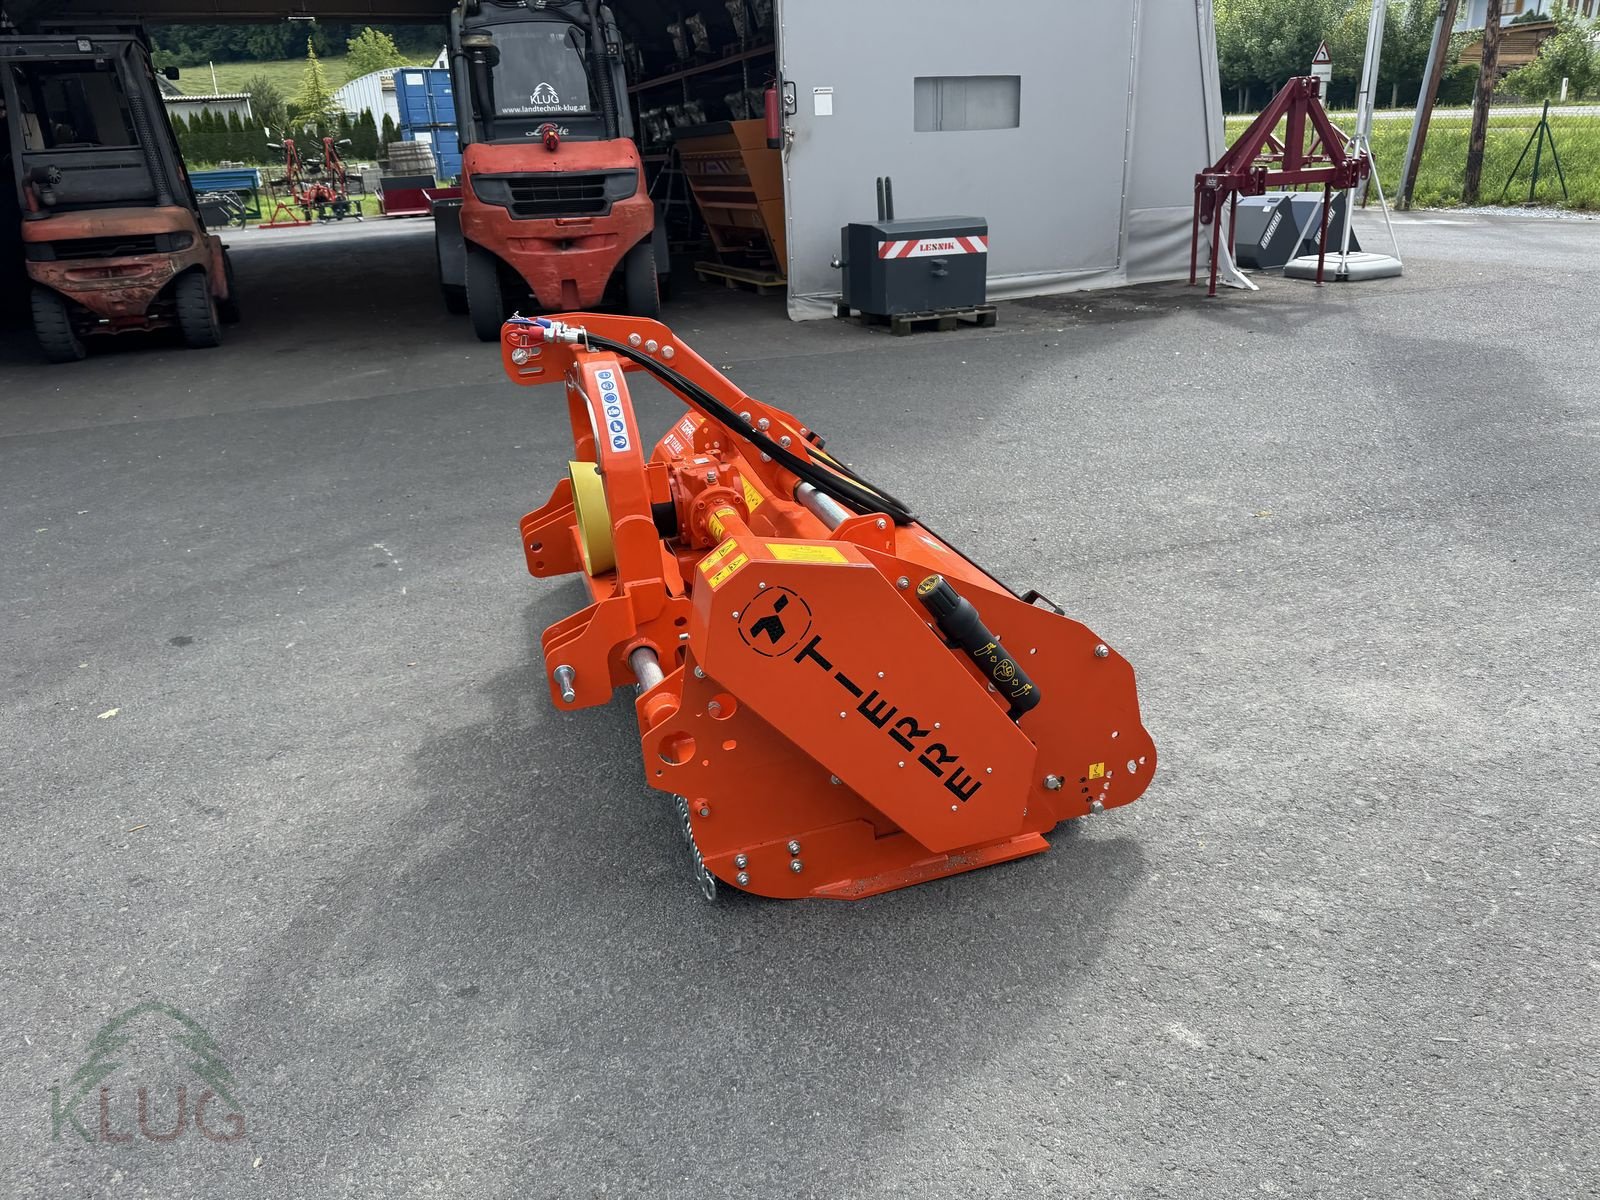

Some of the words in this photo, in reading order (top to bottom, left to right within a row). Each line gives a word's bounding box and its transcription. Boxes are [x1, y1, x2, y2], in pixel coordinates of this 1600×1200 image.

[530, 95, 559, 104] KLUG
[502, 104, 586, 113] www.landtechnik-klug.at
[920, 242, 955, 252] LESNIK
[794, 635, 983, 803] TIERRE
